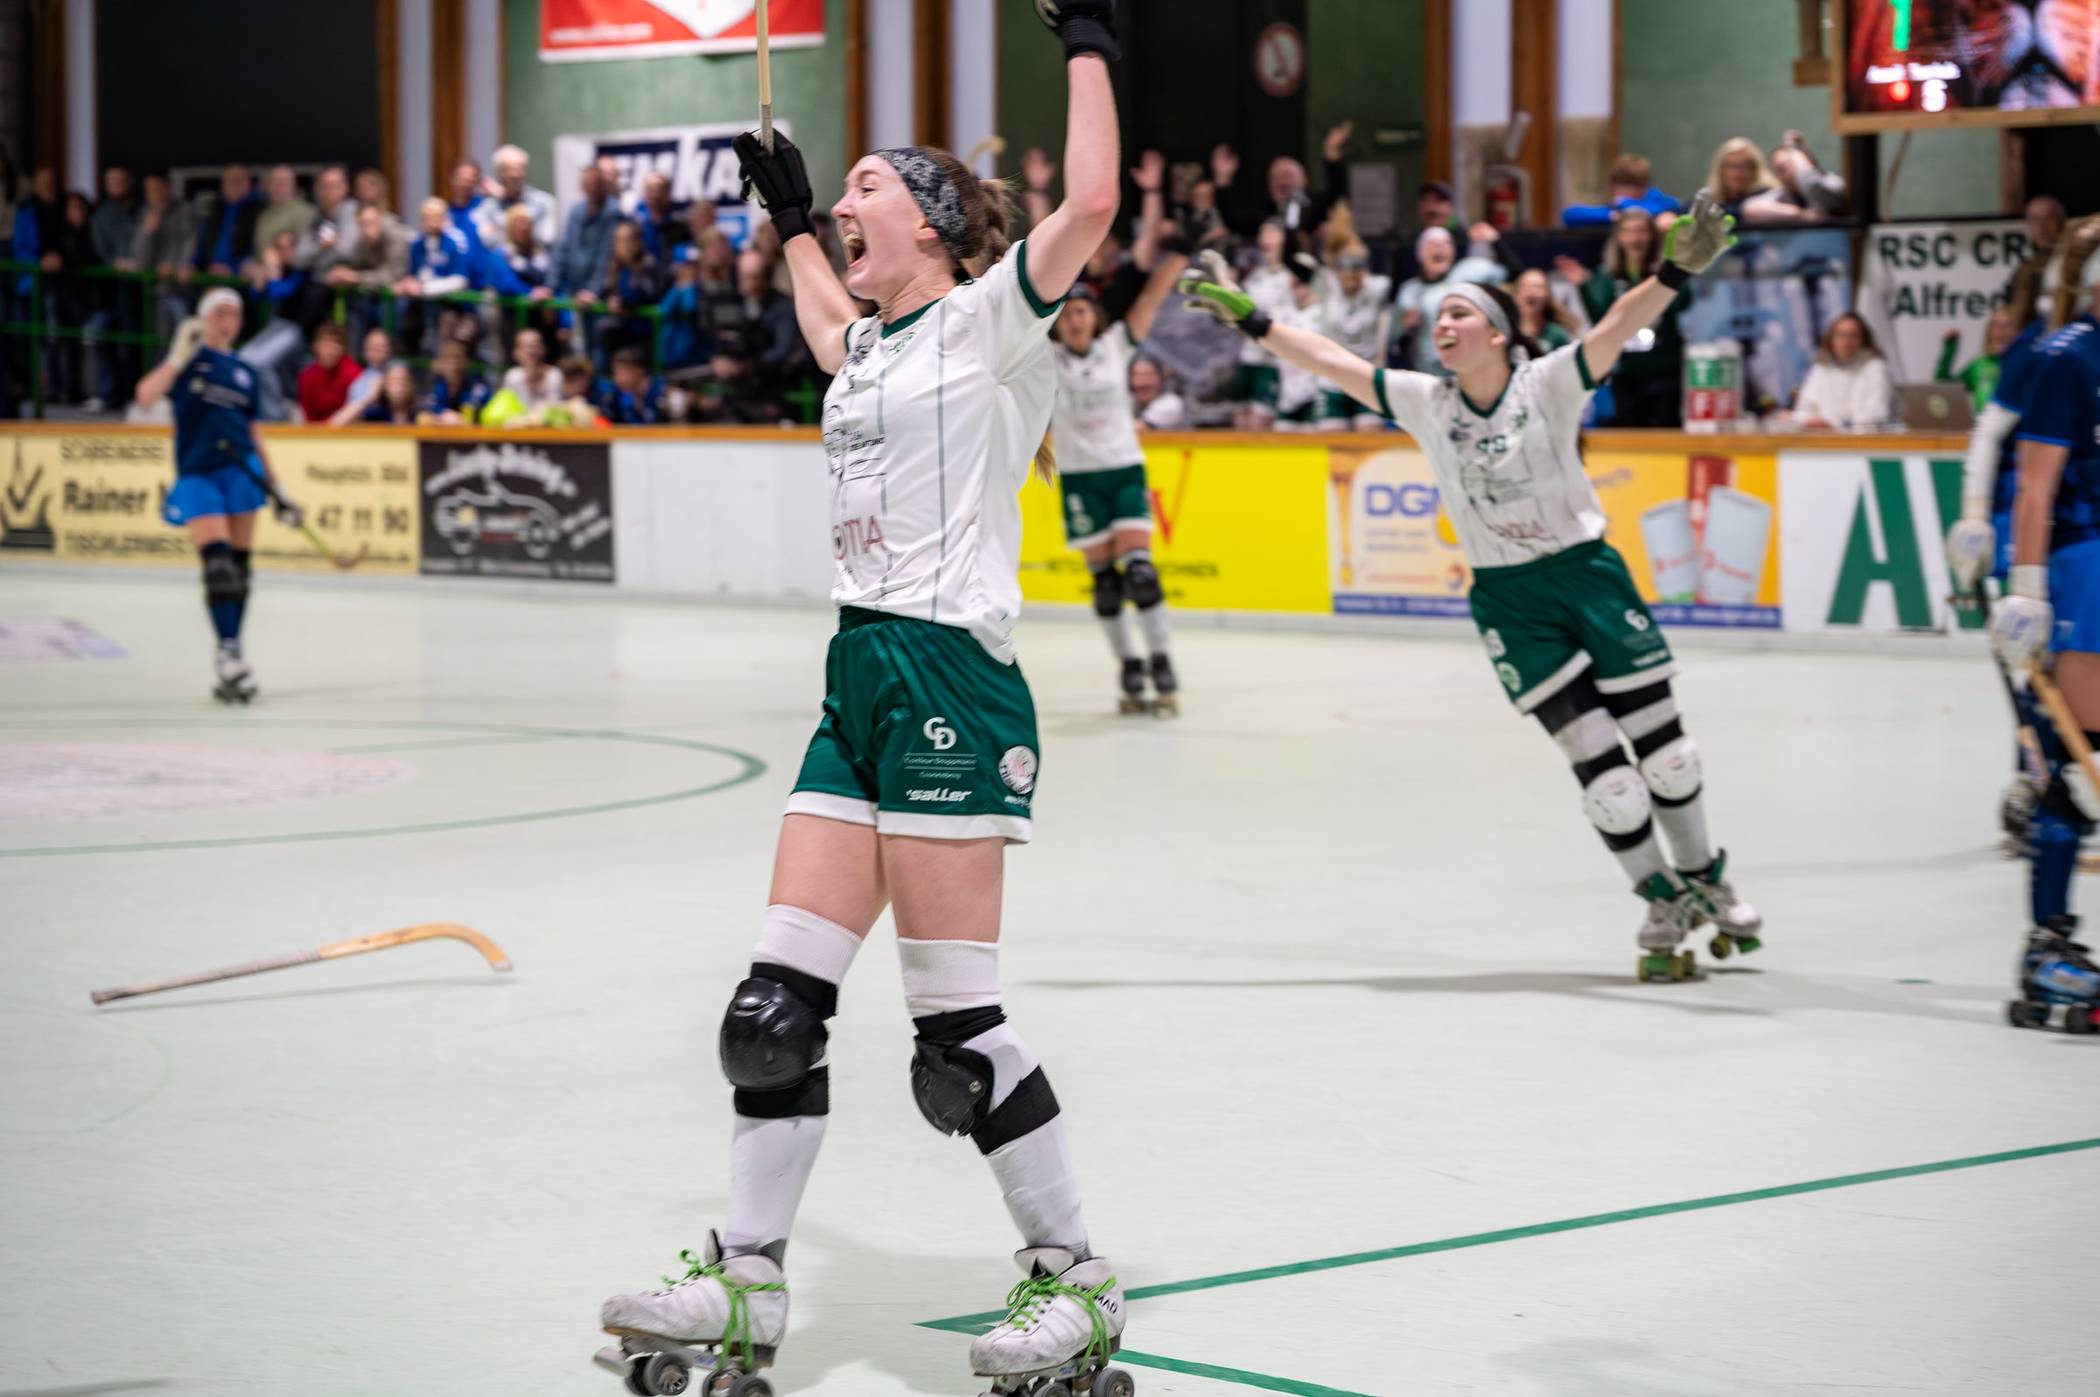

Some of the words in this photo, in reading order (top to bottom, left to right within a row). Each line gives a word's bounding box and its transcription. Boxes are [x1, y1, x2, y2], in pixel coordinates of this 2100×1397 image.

[1879, 233, 1956, 267] RSC
[1973, 232, 2032, 266] CR
[64, 480, 147, 512] Rainer
[907, 787, 972, 802] saller
